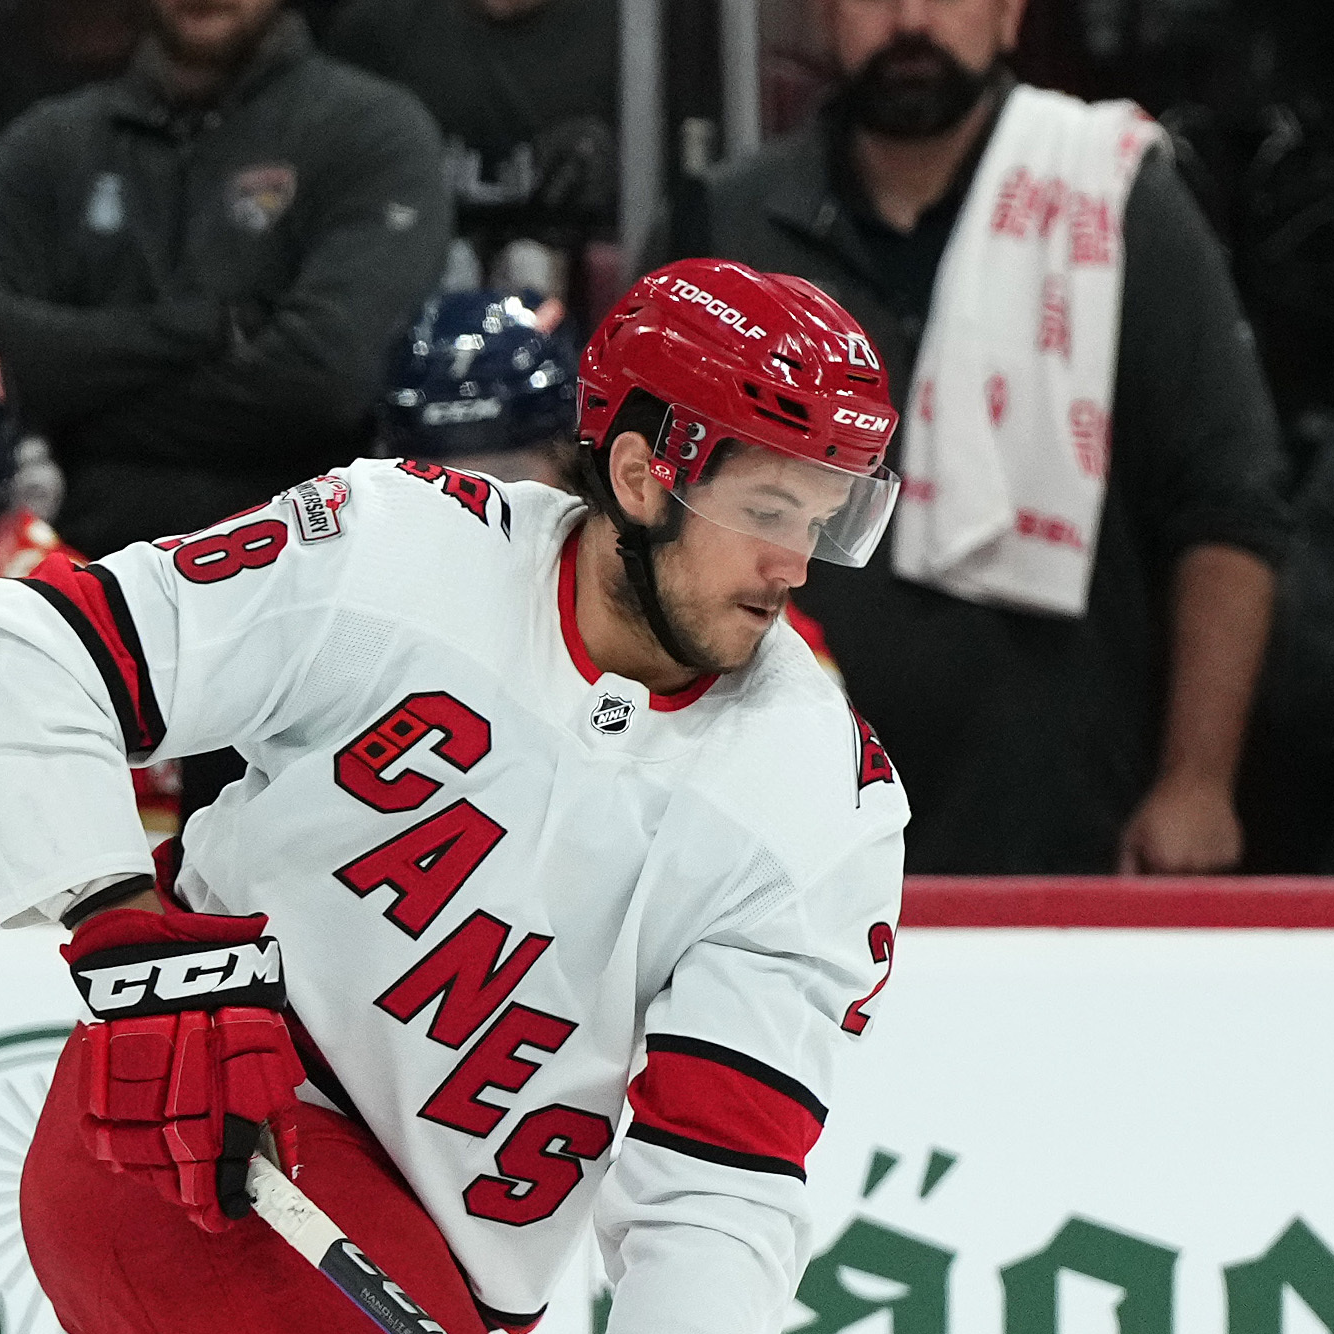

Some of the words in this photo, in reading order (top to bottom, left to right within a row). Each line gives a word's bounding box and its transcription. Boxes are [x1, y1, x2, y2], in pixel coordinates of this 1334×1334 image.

[670, 278, 766, 340] TOPGOLF
[833, 407, 889, 432] CCM
[77, 940, 280, 1012] CCM
[332, 690, 615, 1228] CANES
